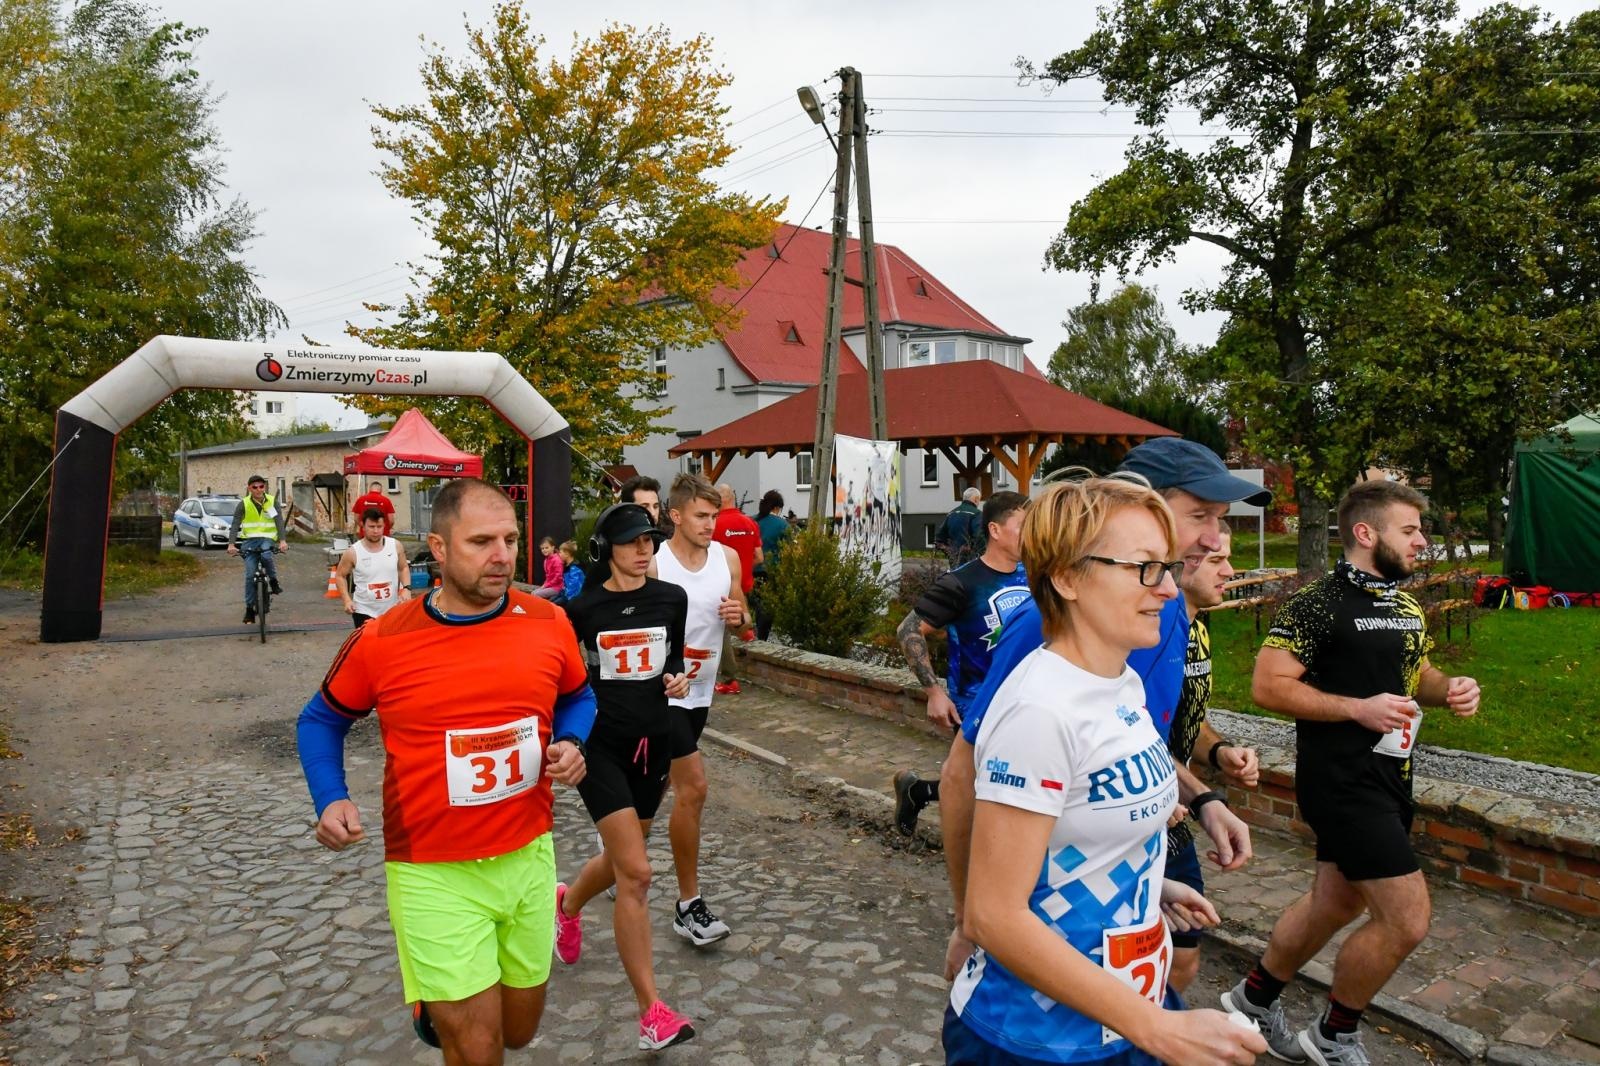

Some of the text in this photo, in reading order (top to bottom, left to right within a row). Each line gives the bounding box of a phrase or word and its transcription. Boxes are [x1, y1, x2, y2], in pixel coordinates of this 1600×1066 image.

[287, 349, 421, 363] Elektroniczny pomiar czasu
[285, 365, 427, 387] ZmierzymyCzas.pl
[375, 588, 391, 599] 13
[615, 647, 653, 674] 11
[686, 661, 702, 679] 2
[1400, 721, 1411, 750] 5
[470, 750, 524, 794] 31
